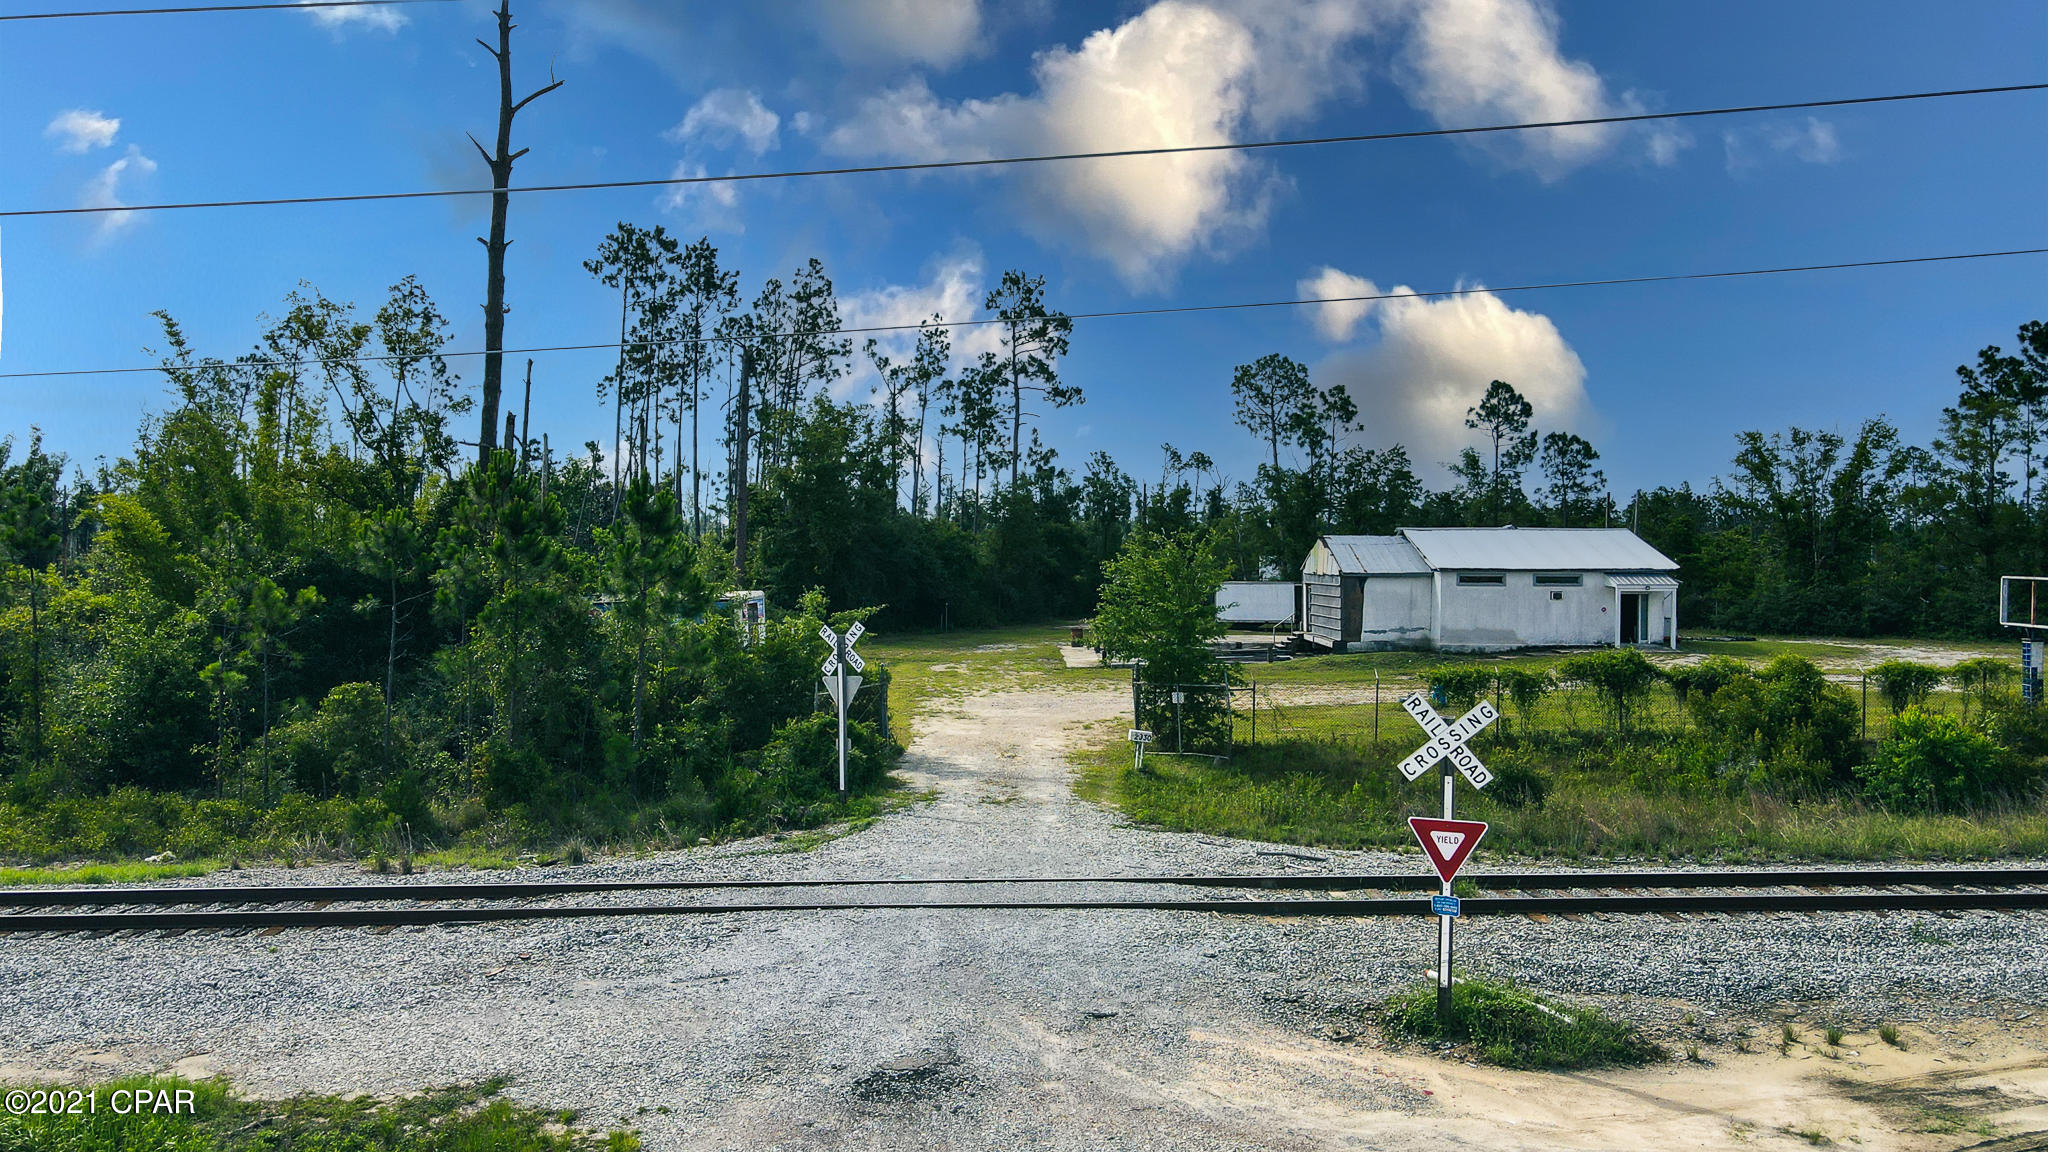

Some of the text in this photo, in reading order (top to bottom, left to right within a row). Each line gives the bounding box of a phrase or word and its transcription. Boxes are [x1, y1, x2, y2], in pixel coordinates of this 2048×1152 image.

[846, 649, 863, 670] ROAD
[1403, 705, 1494, 777] CROSSING
[1407, 697, 1487, 785] RAIL ROAD
[1436, 835, 1459, 845] YIELD
